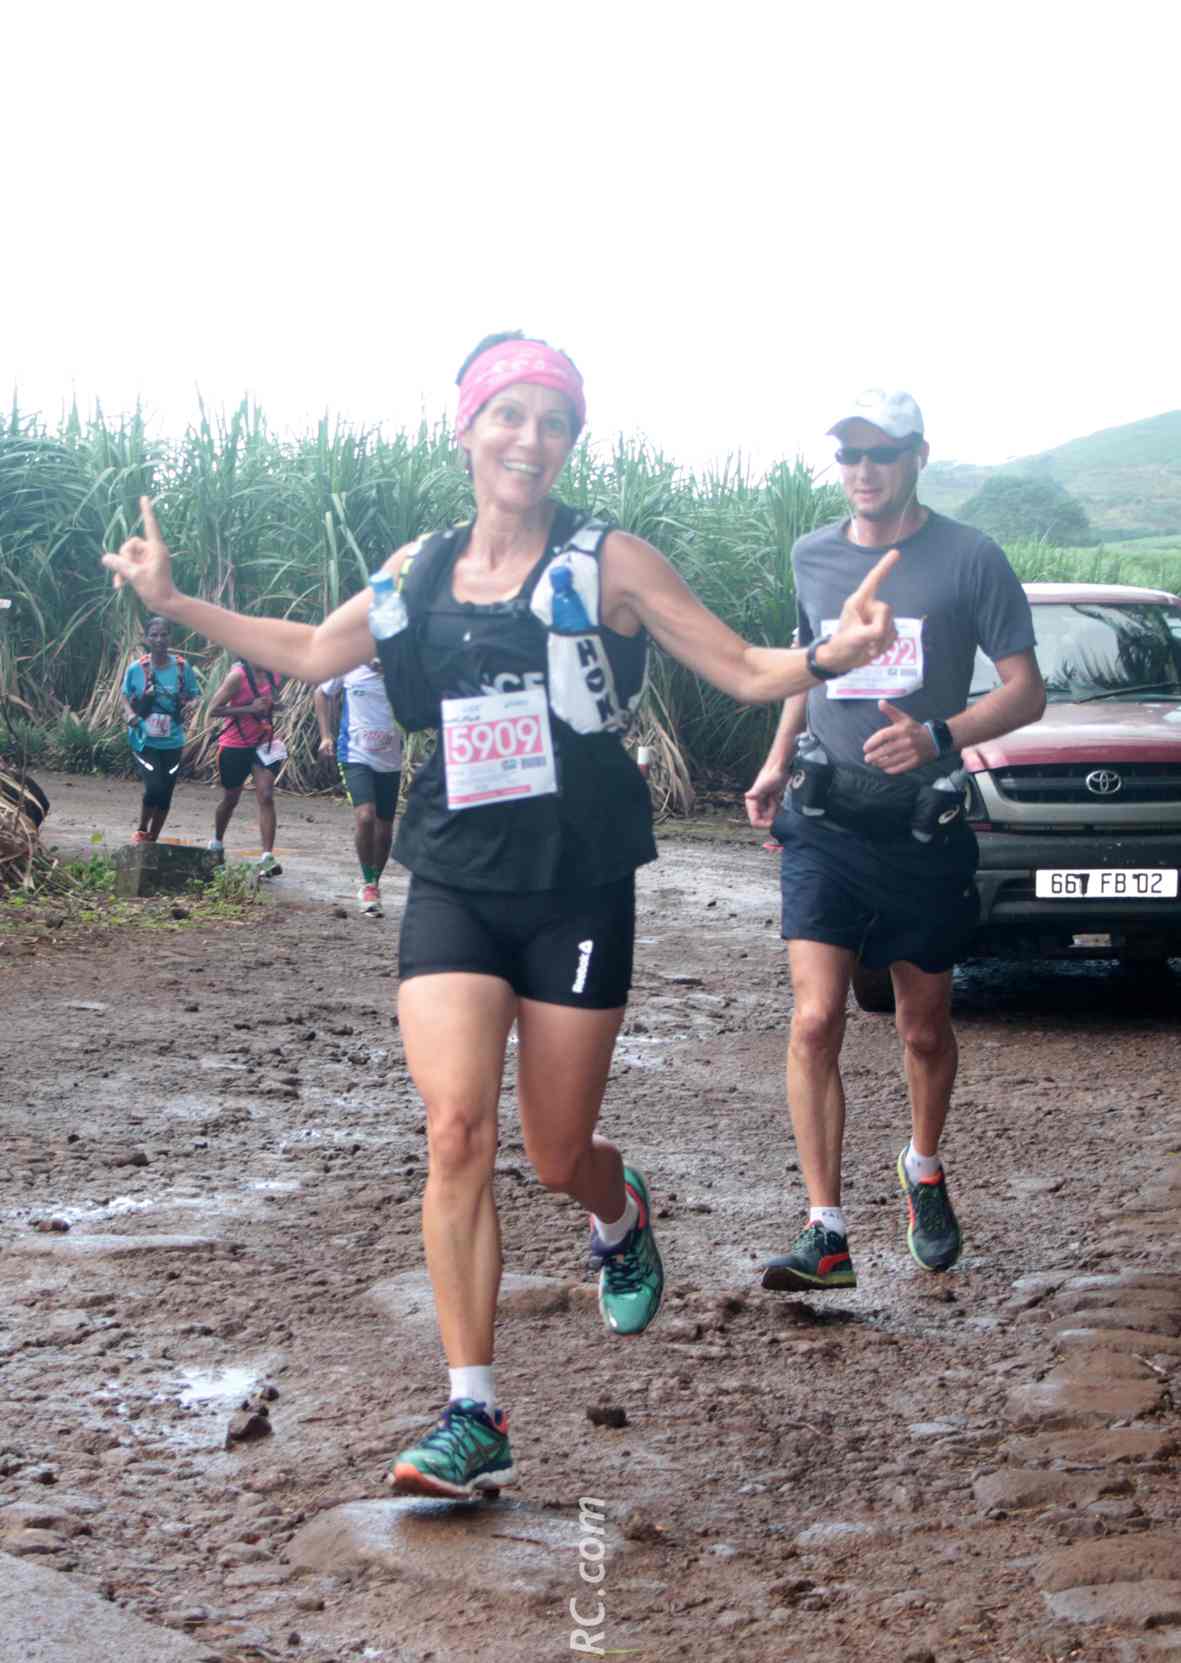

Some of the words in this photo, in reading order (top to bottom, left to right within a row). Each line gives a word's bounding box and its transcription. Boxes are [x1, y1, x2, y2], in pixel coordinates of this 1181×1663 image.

[451, 718, 539, 762] 5909
[1051, 873, 1090, 895] 667
[1101, 873, 1126, 893] FB
[1136, 873, 1162, 893] 02
